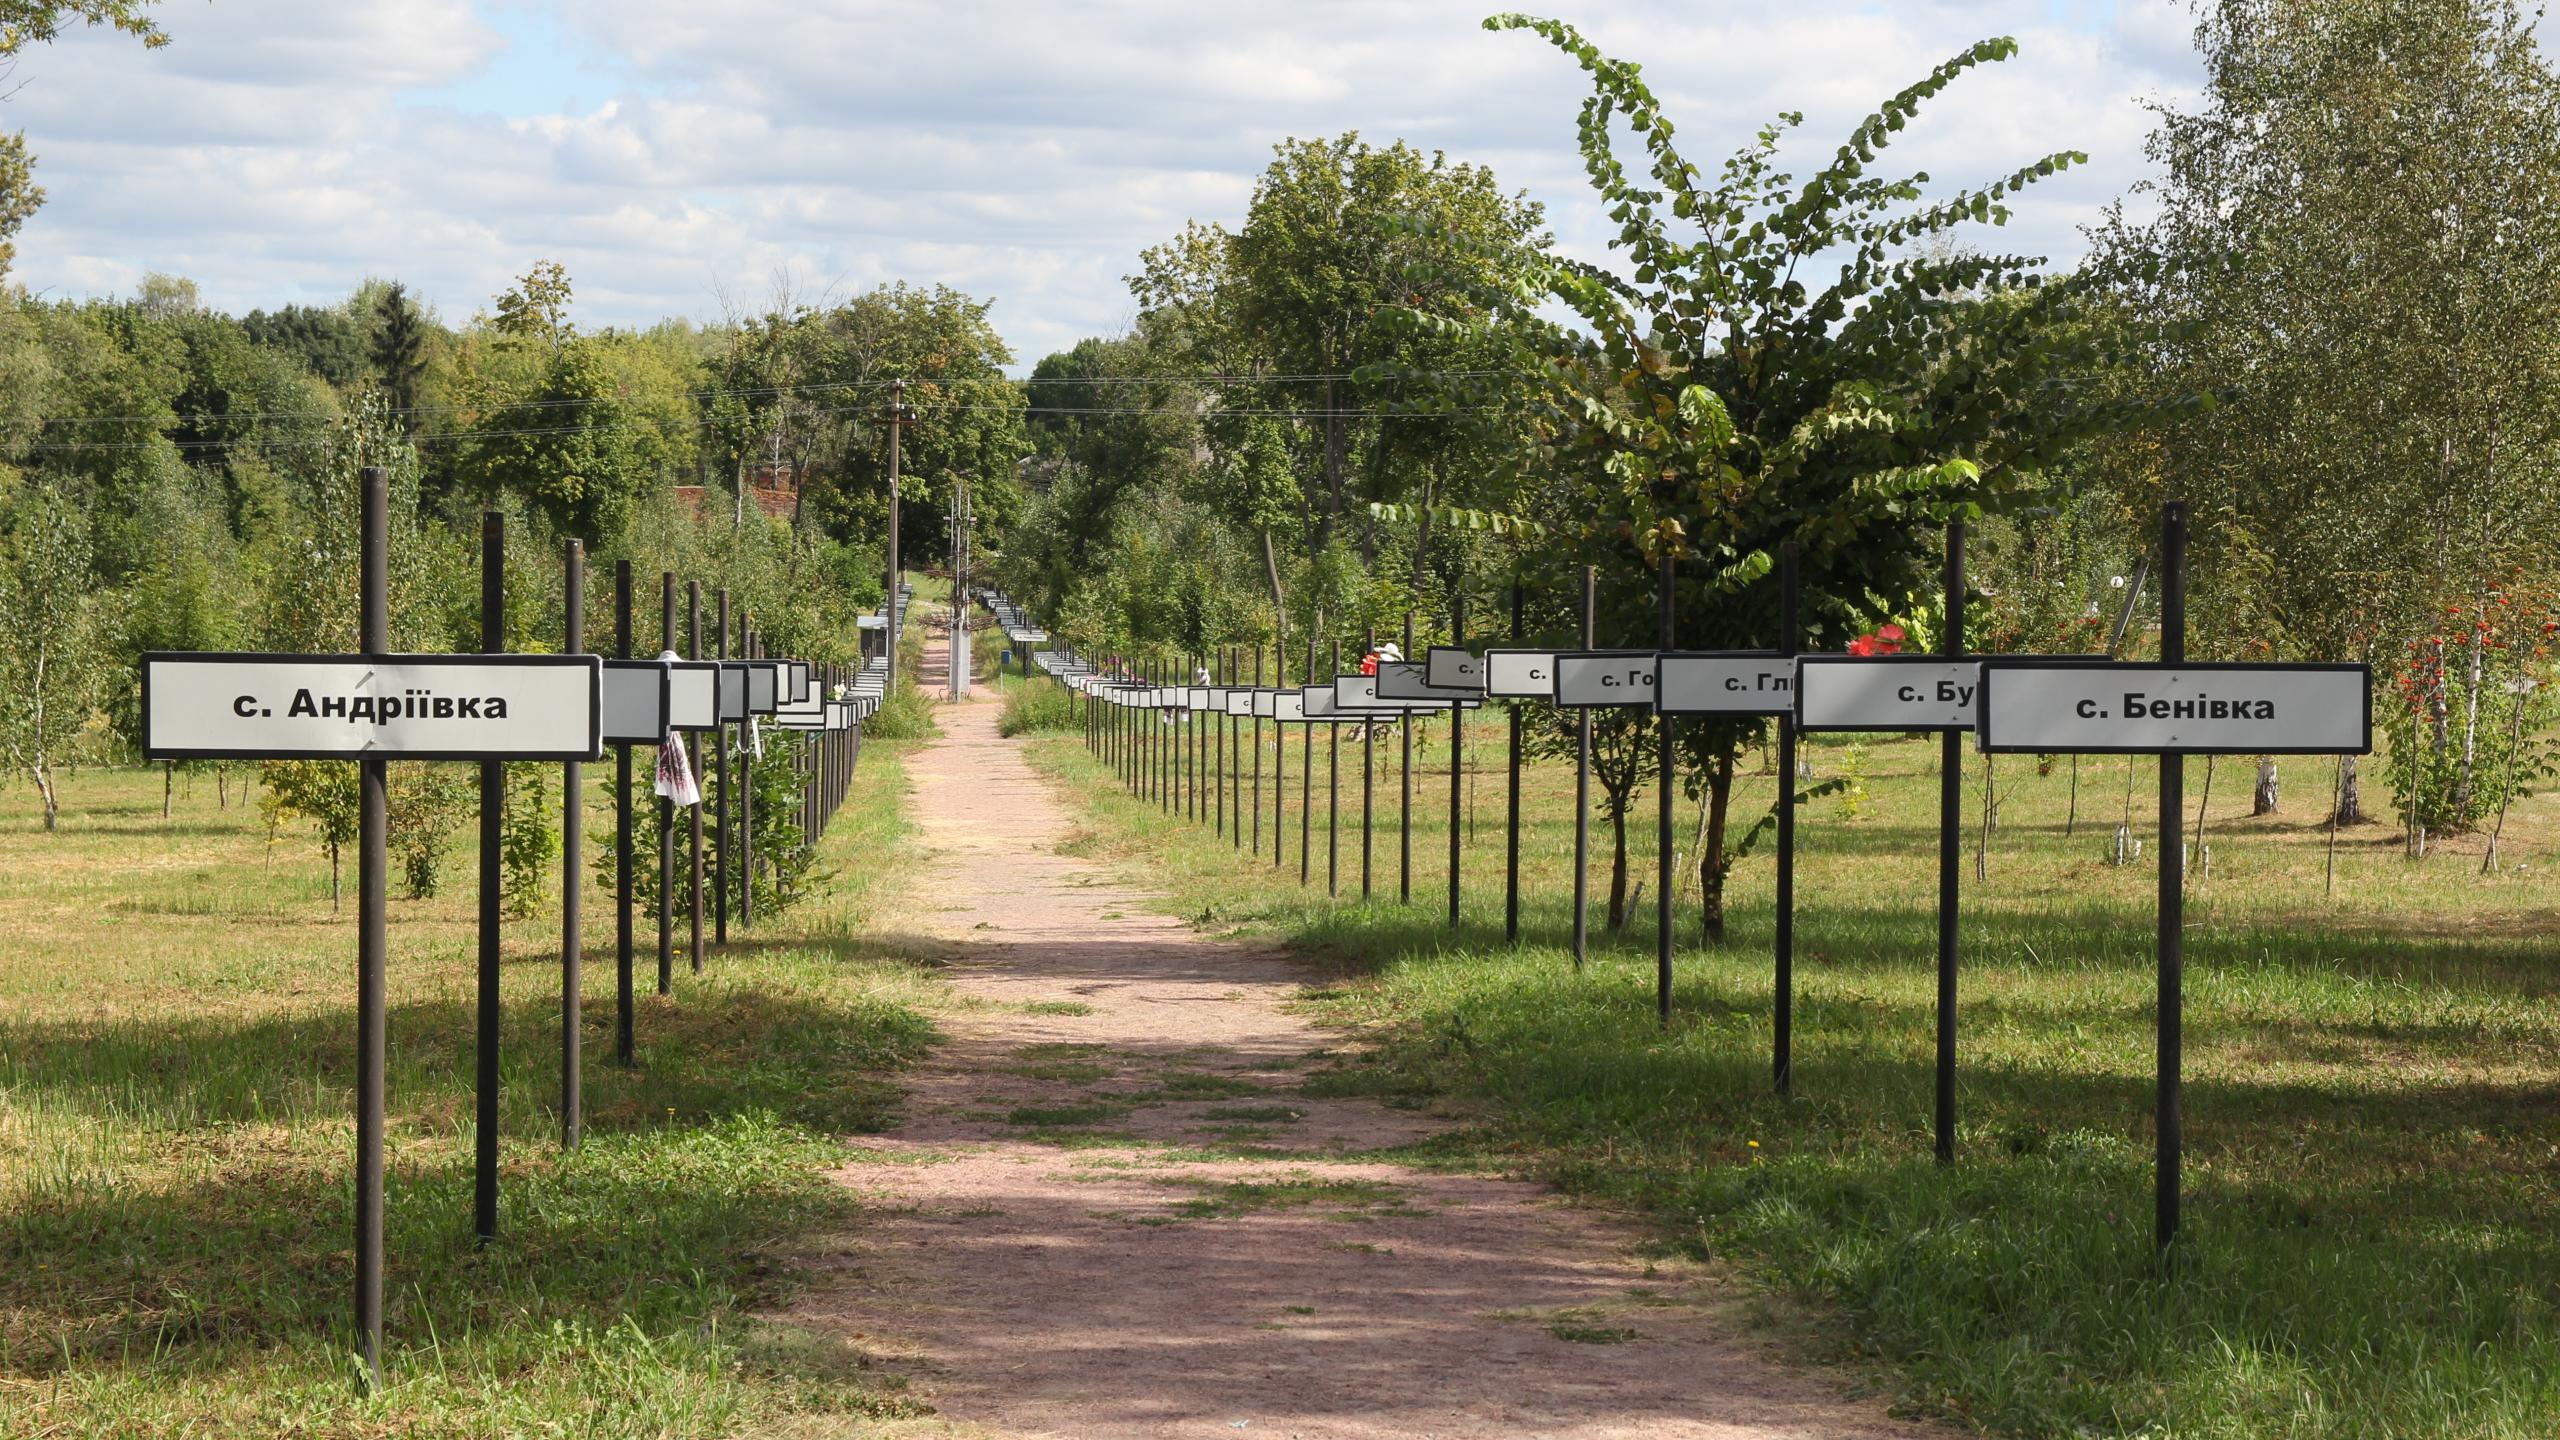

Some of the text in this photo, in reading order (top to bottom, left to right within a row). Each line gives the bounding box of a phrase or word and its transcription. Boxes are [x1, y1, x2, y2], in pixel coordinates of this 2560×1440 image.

[1458, 664, 1474, 674] с.
[1529, 669, 1547, 681] с.
[1602, 675, 1621, 687] с.
[1724, 673, 1793, 691] с. Гл
[1897, 680, 1975, 708] с. Бу
[233, 688, 508, 726] с. Андріївка
[2076, 692, 2275, 720] с. Бенівка
